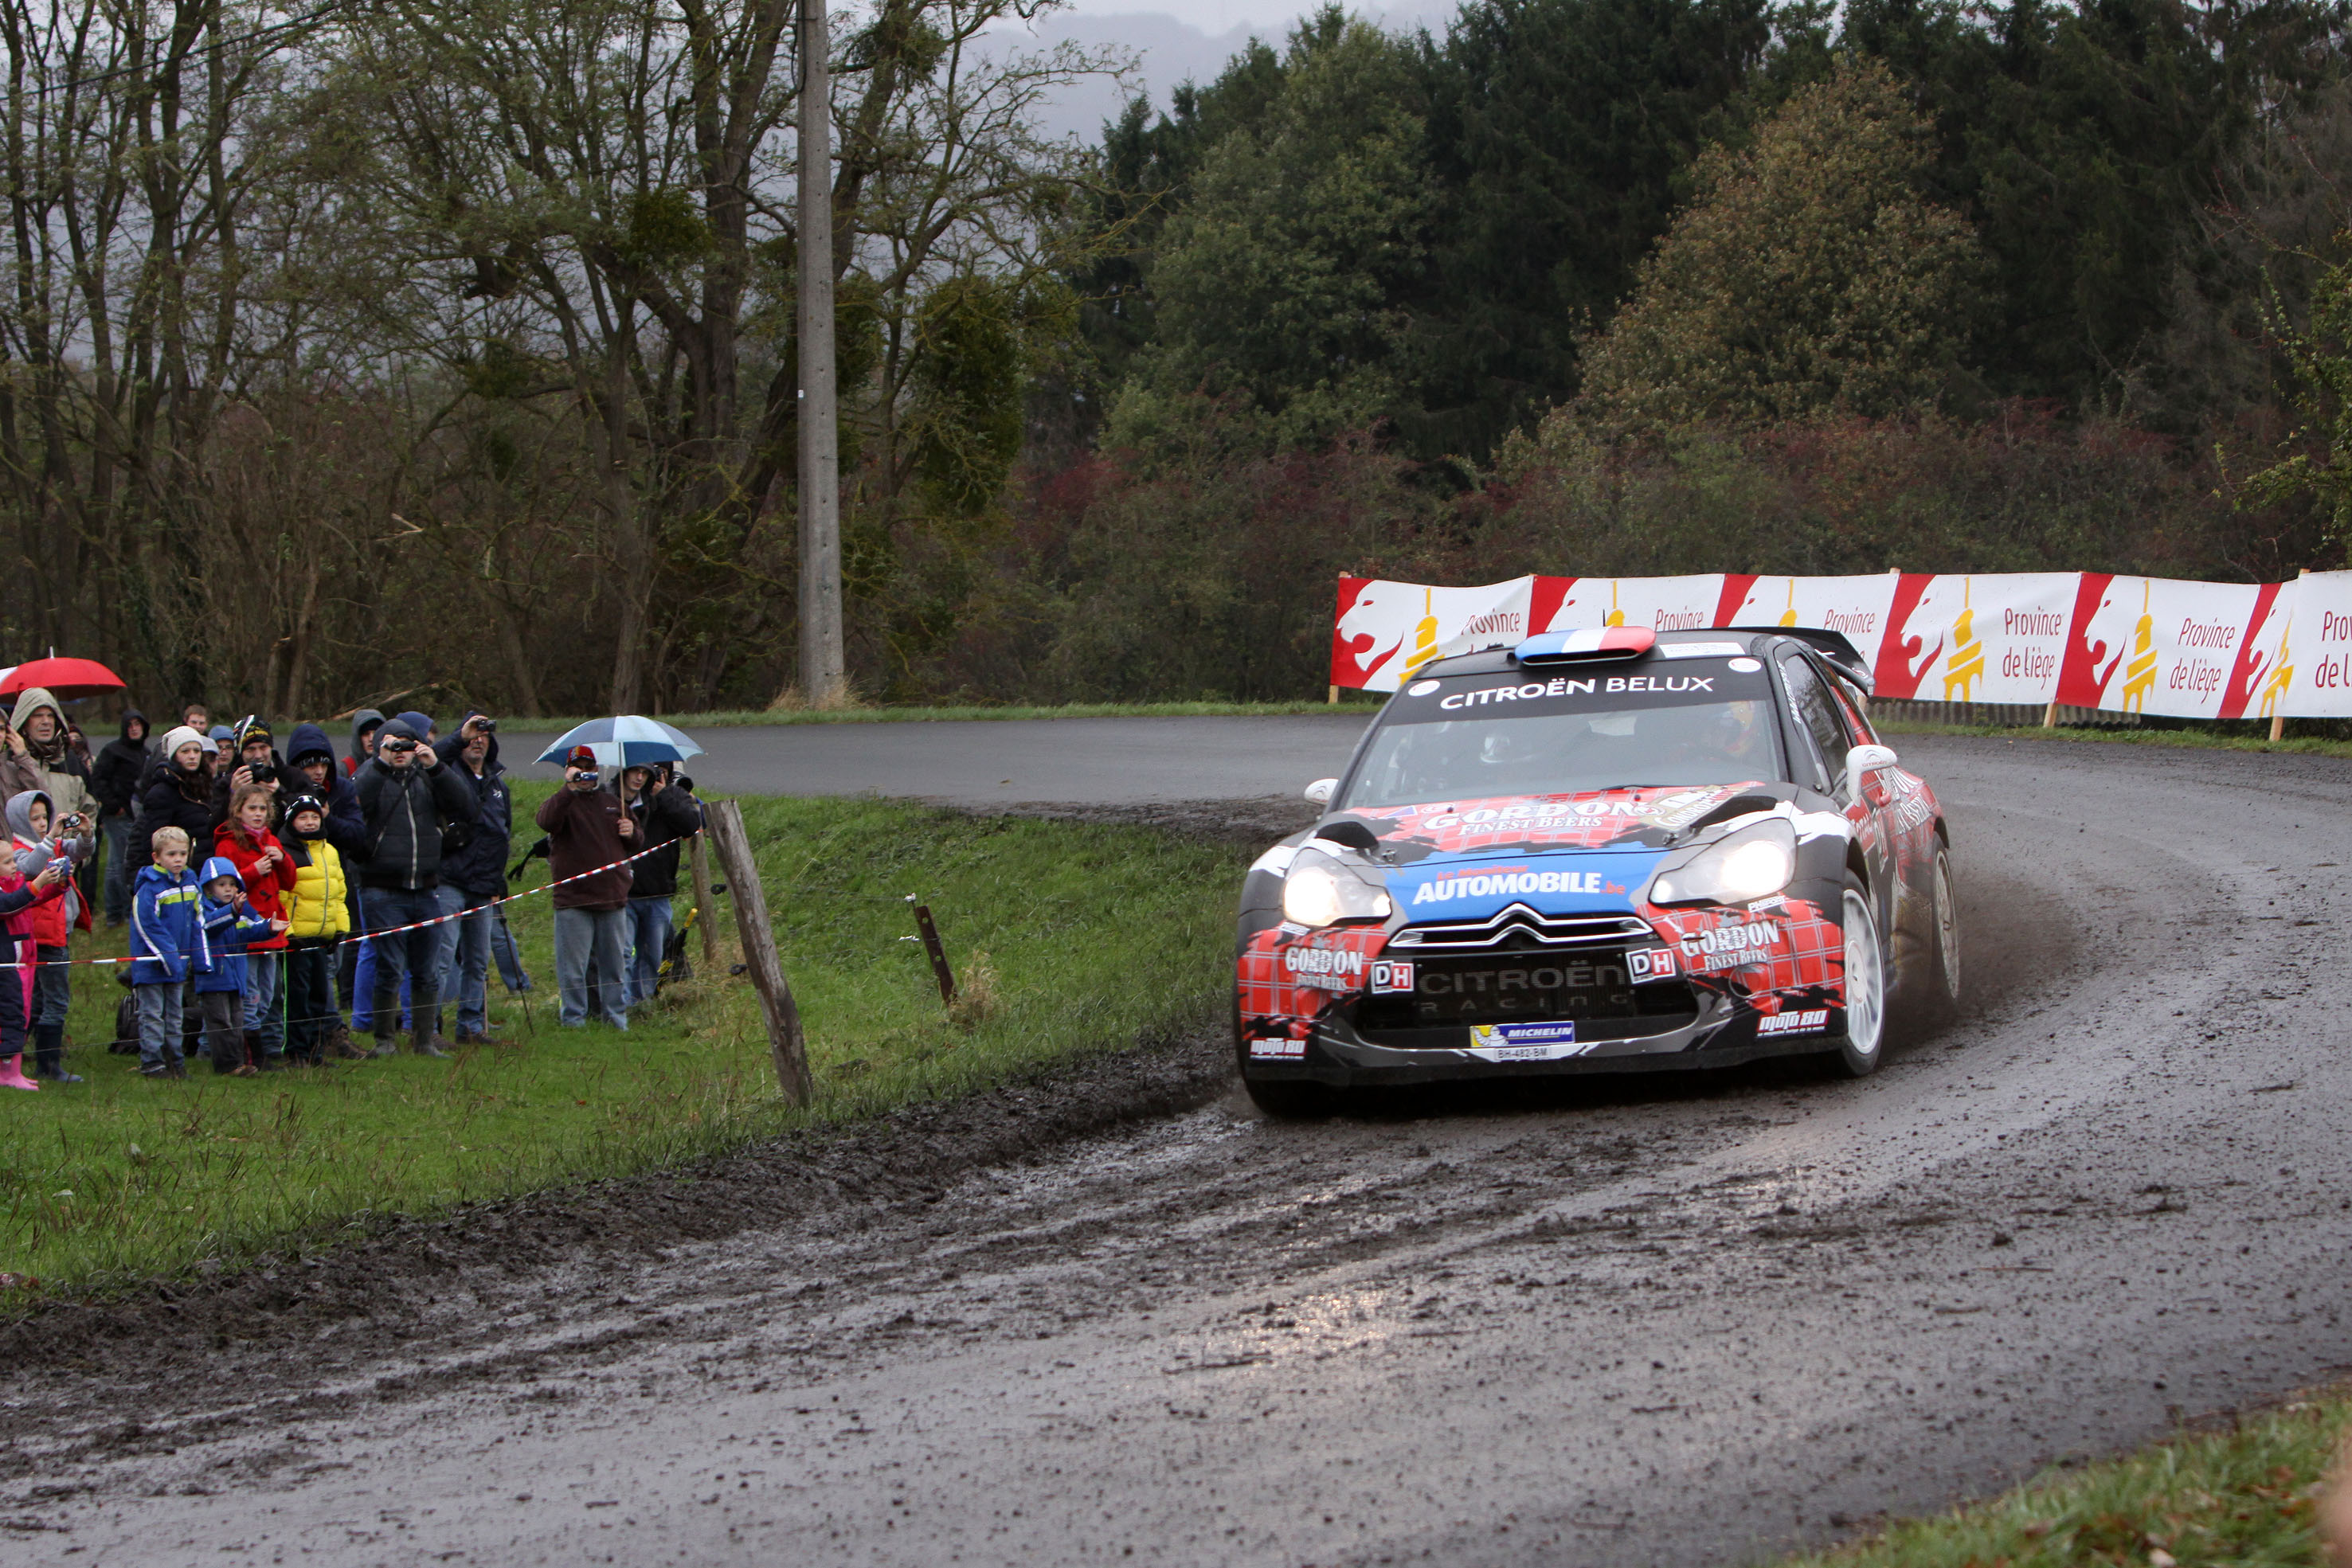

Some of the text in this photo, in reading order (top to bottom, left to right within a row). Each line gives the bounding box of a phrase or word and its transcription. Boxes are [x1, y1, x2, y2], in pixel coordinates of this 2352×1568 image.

[1654, 606, 1704, 632] Province
[1823, 607, 1875, 635] Province
[2004, 605, 2061, 635] Province
[2177, 617, 2235, 649] Province
[2002, 646, 2021, 678] de
[2170, 657, 2187, 690] de
[2315, 654, 2338, 688] de
[1440, 677, 1595, 710] CITROËN
[1606, 677, 1715, 692] BELUX
[1423, 800, 1644, 831] GORDON
[1458, 816, 1603, 836] FINEST BEERS
[1680, 920, 1780, 957] GORDON
[1286, 946, 1364, 976] GORDON
[1508, 1027, 1572, 1038] MICHELIN
[1800, 1010, 1828, 1026] 80
